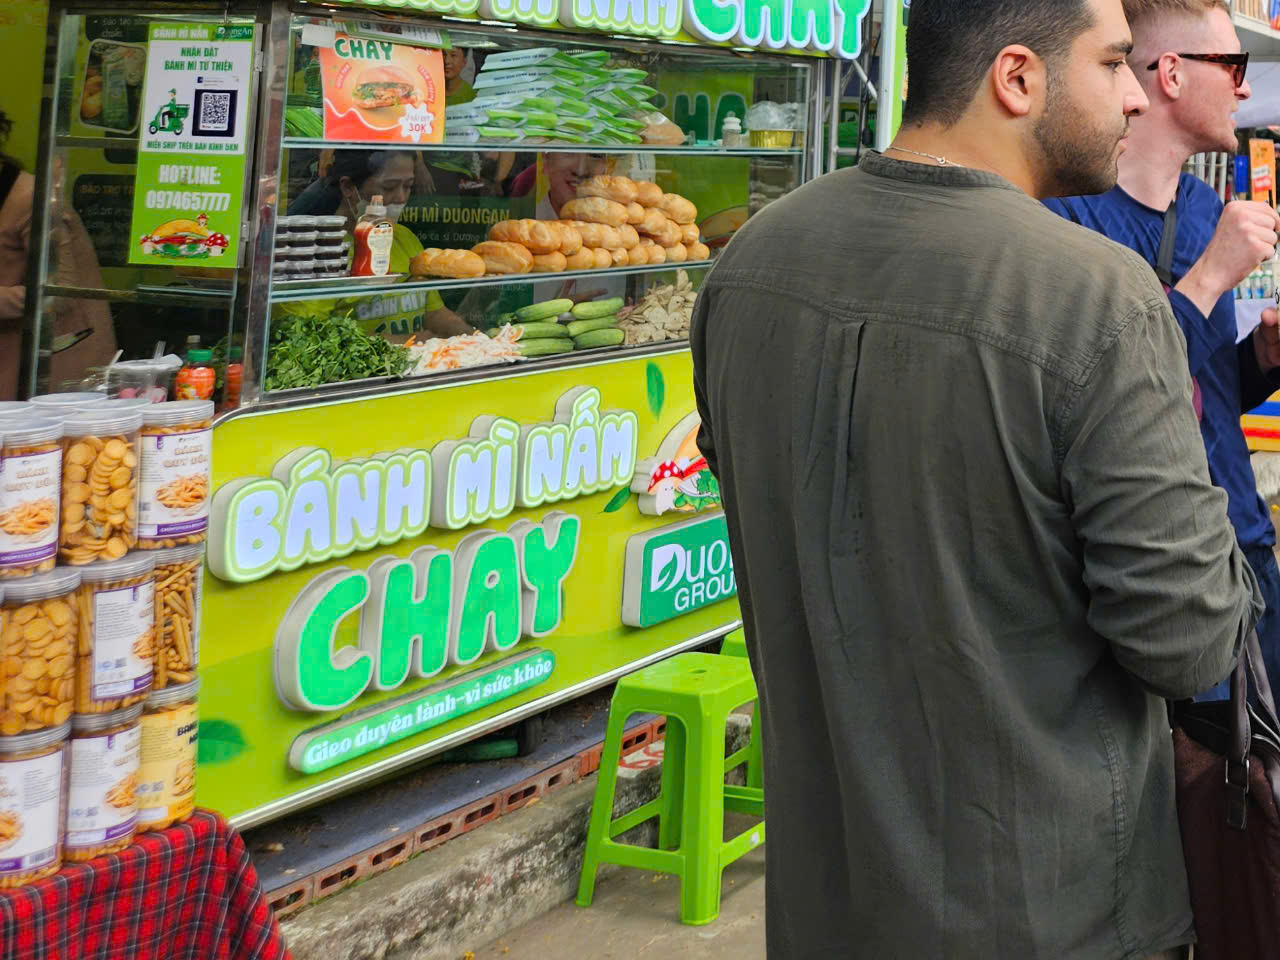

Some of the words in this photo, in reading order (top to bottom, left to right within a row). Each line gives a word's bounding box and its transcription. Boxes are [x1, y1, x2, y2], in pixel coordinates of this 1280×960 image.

[334, 38, 393, 61] CHAY
[408, 123, 427, 133] 30K
[159, 164, 221, 185] HOTLINE:
[145, 190, 231, 212] 0974657777
[400, 206, 418, 223] NH
[422, 203, 439, 223] MÌ
[442, 207, 510, 224] DUONGAN
[226, 447, 432, 583] BÁNH
[445, 417, 520, 530] MÌ
[522, 386, 638, 508] NẤM
[650, 539, 733, 593] Duo
[674, 571, 738, 612] GROU
[298, 512, 580, 712] CHAY
[306, 737, 353, 766] Gieo
[355, 712, 414, 748] duyên
[483, 674, 512, 697] sức
[514, 657, 553, 689] khỏe
